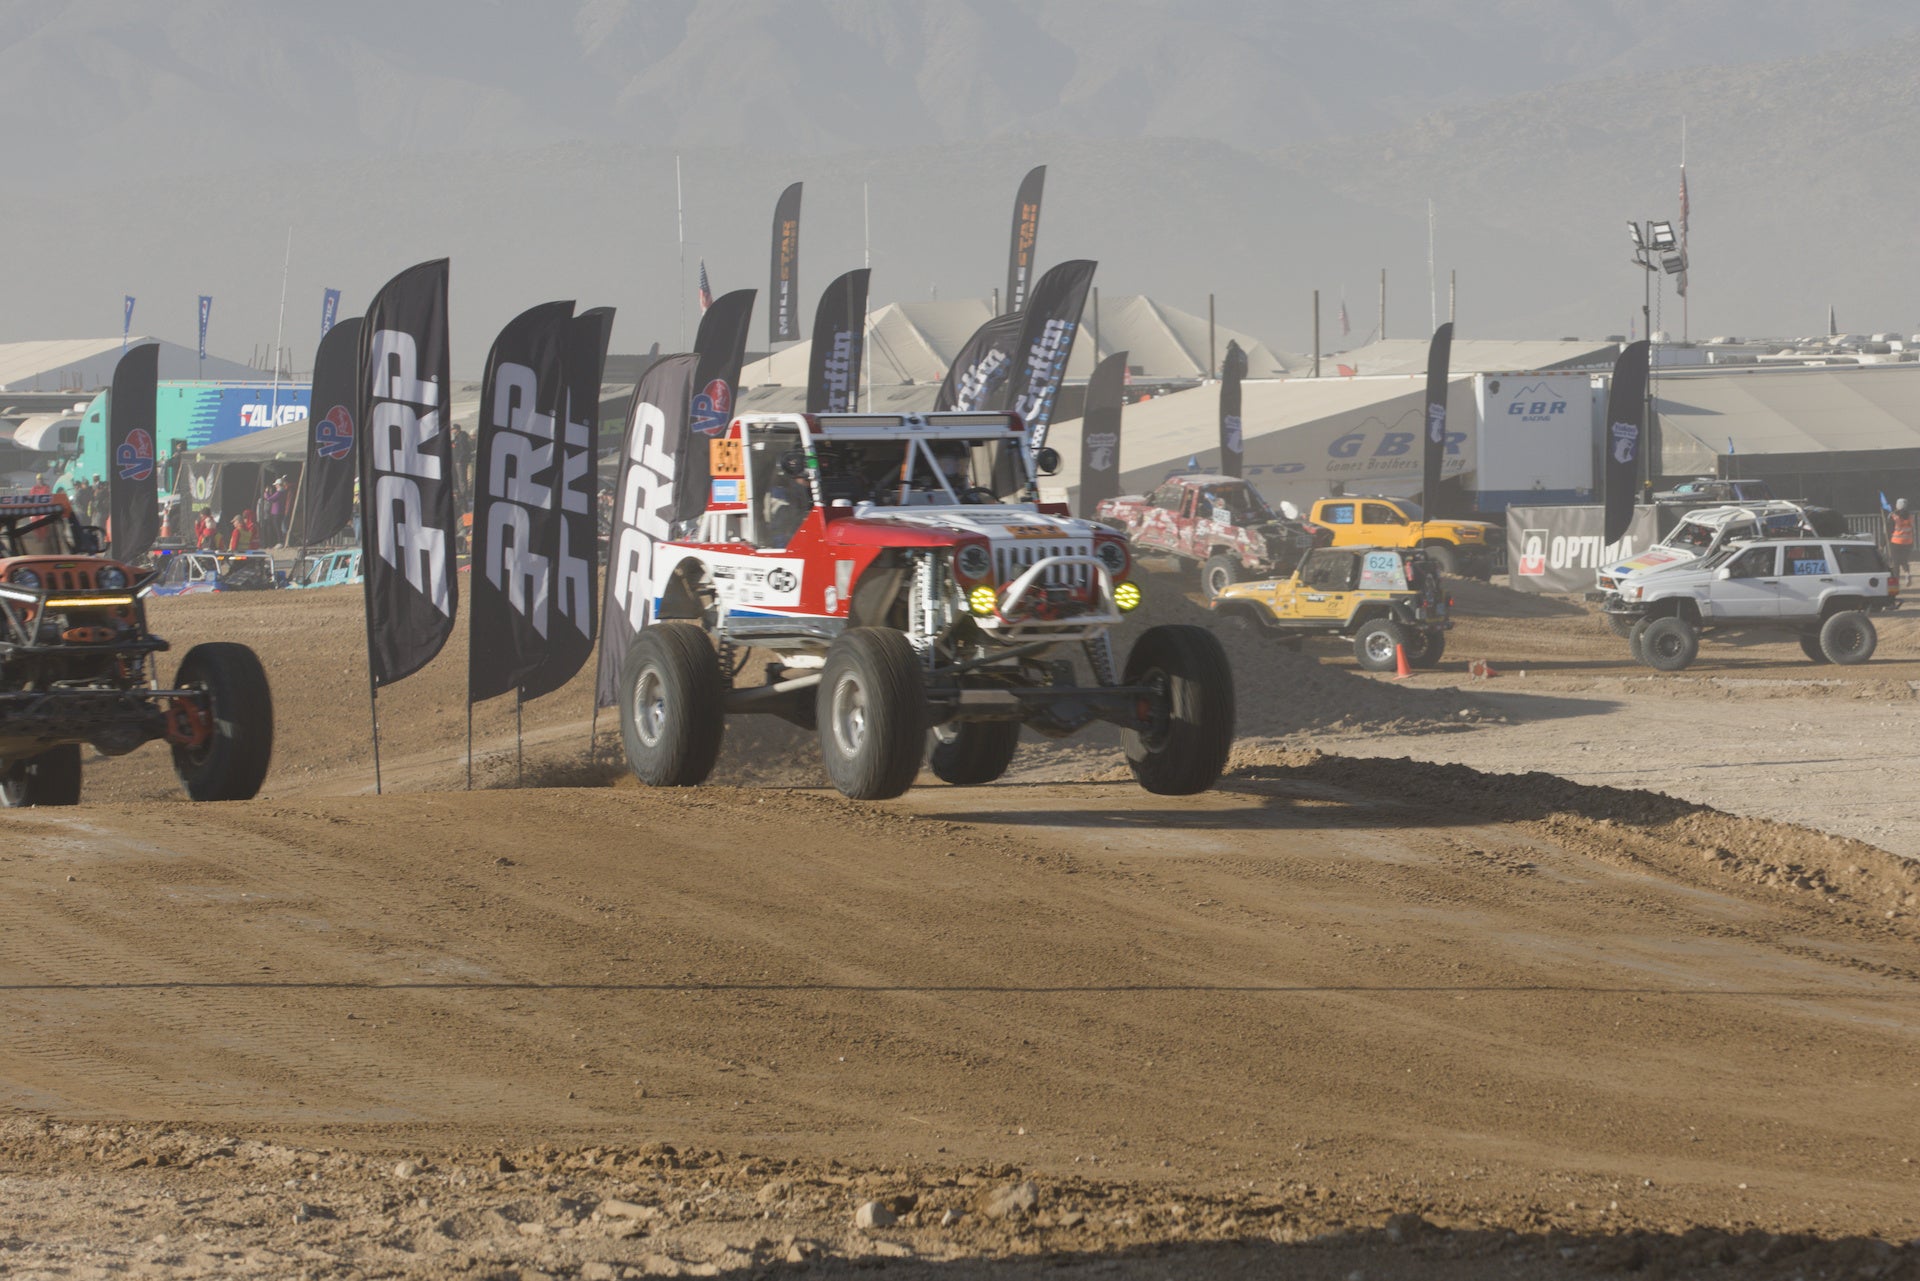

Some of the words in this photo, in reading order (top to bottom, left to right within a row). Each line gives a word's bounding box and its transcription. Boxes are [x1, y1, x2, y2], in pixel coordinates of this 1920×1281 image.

[951, 347, 1007, 412] riffin
[1014, 318, 1066, 421] Griffin
[689, 393, 730, 433] VP
[1507, 400, 1567, 415] GBR
[315, 419, 354, 457] VP
[116, 443, 153, 480] VP
[371, 328, 450, 618] PRP
[485, 361, 556, 641] PRP
[1369, 556, 1394, 569] 624
[1797, 562, 1826, 574] 4674
